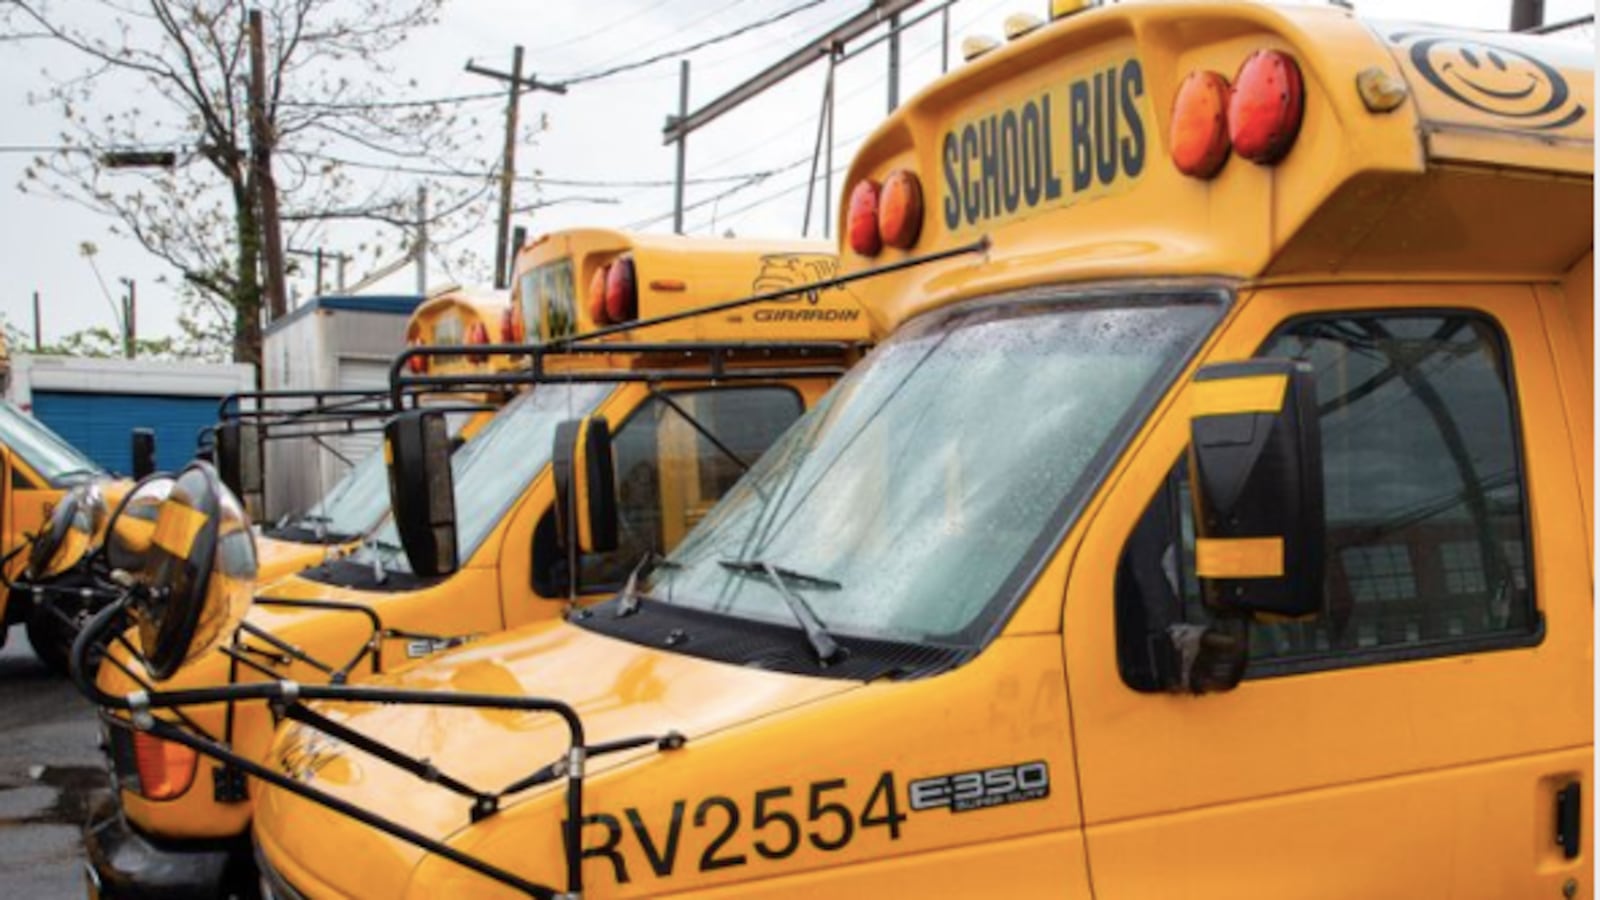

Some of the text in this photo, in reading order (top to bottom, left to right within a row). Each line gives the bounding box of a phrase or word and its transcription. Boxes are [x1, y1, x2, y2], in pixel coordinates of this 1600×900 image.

[943, 58, 1145, 230] SCHOOL BUS
[753, 308, 859, 323] GIRARDIN
[909, 762, 1048, 809] E-350
[561, 771, 907, 884] RV2554
